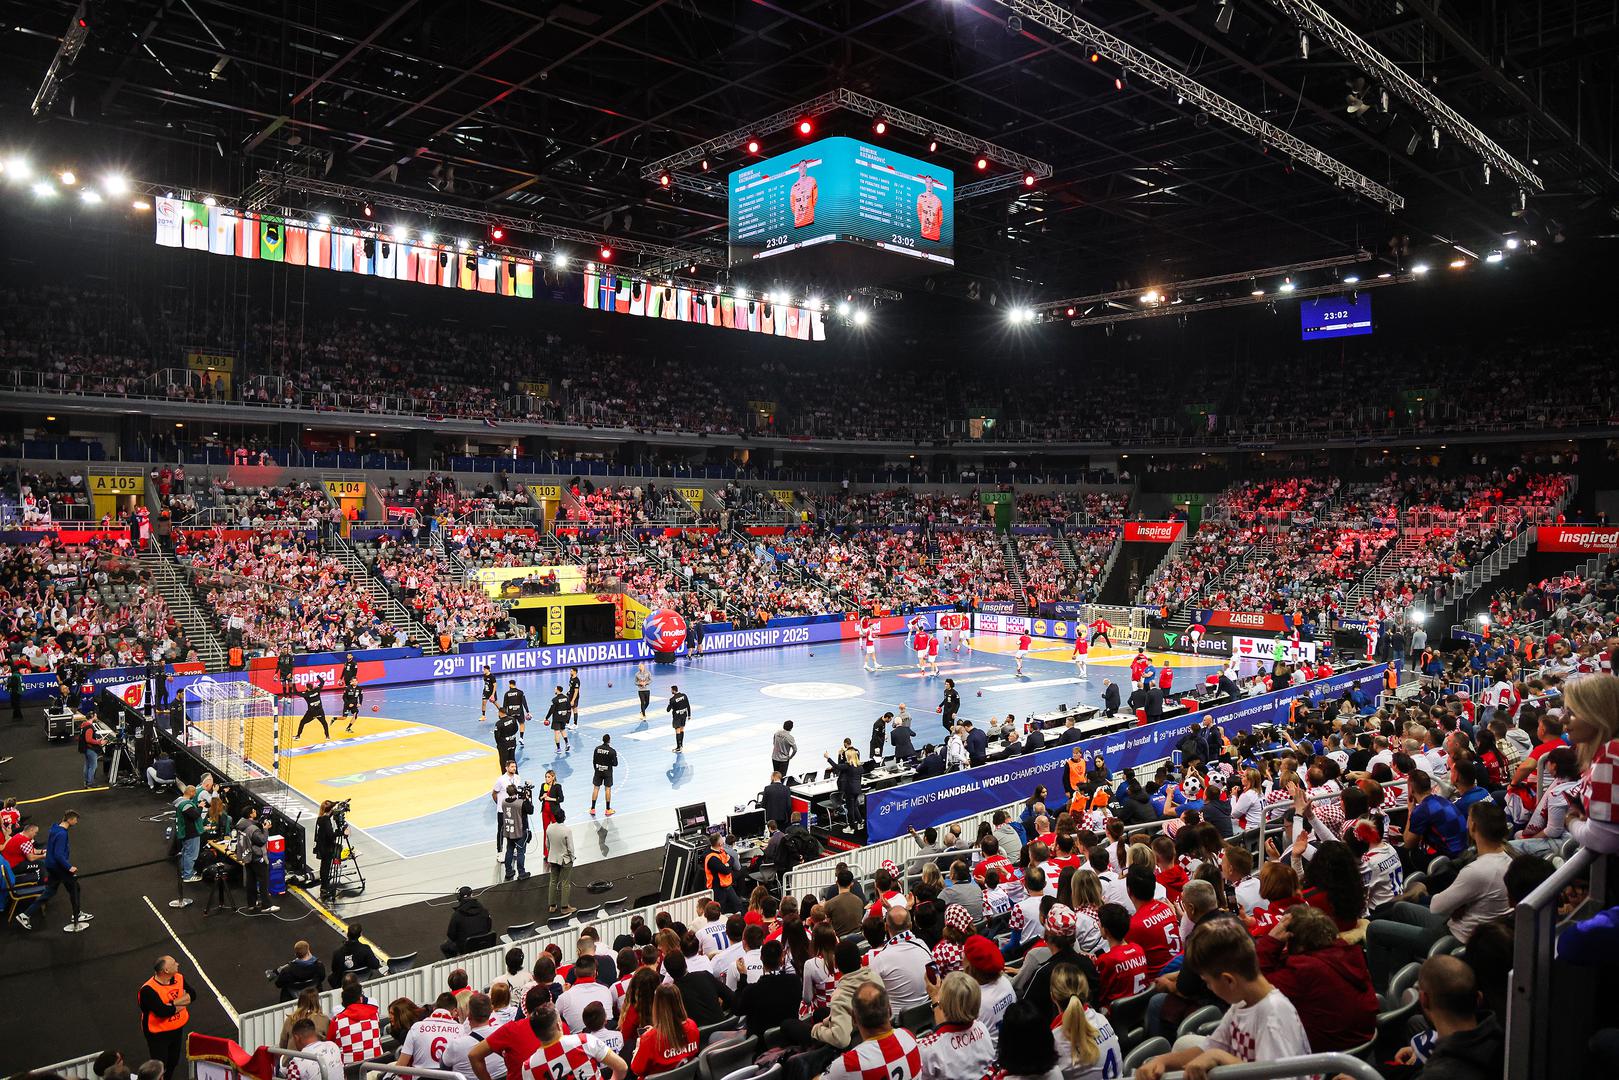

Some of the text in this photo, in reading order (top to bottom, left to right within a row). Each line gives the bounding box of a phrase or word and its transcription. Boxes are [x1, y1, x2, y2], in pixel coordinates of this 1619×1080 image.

[766, 235, 788, 248] 23:02
[891, 234, 915, 247] 23:02
[1324, 311, 1348, 320] 23:02
[196, 356, 226, 366] A 303
[97, 478, 136, 488] A 105
[330, 483, 359, 492] A 104
[540, 487, 555, 495] 103
[1137, 526, 1172, 536] inspired
[1559, 531, 1619, 545] inspired
[980, 614, 998, 622] LIQUI
[1006, 617, 1024, 625] LIQUI
[1230, 614, 1264, 625] ZAGREB
[980, 623, 998, 631] MOLY
[1006, 625, 1025, 634] MOLY
[433, 656, 464, 676] 29th
[470, 655, 496, 673] IHF
[502, 650, 552, 670] MEN'S
[557, 642, 633, 665] HANDBALL
[783, 628, 809, 643] 2025
[95, 676, 124, 684] WORLD
[1217, 713, 1233, 725] WORLD
[1234, 705, 1263, 720] CHAMPIONSHIP
[1106, 741, 1125, 754] inspired
[1126, 739, 1133, 749] by
[1133, 735, 1151, 747] handball
[880, 801, 897, 815] 29TH
[897, 800, 908, 811] IHF
[911, 792, 936, 807] MEN'S
[937, 782, 980, 800] HANDBALL
[982, 774, 1010, 788] WORLD
[1011, 761, 1059, 781] CHAMPIONSHIP
[1164, 923, 1180, 956] 5
[1115, 956, 1147, 974] DUVNJA
[420, 1025, 459, 1034] ŠOŠTARIĆ
[430, 1037, 448, 1062] 6
[664, 1042, 698, 1058] CROATIA
